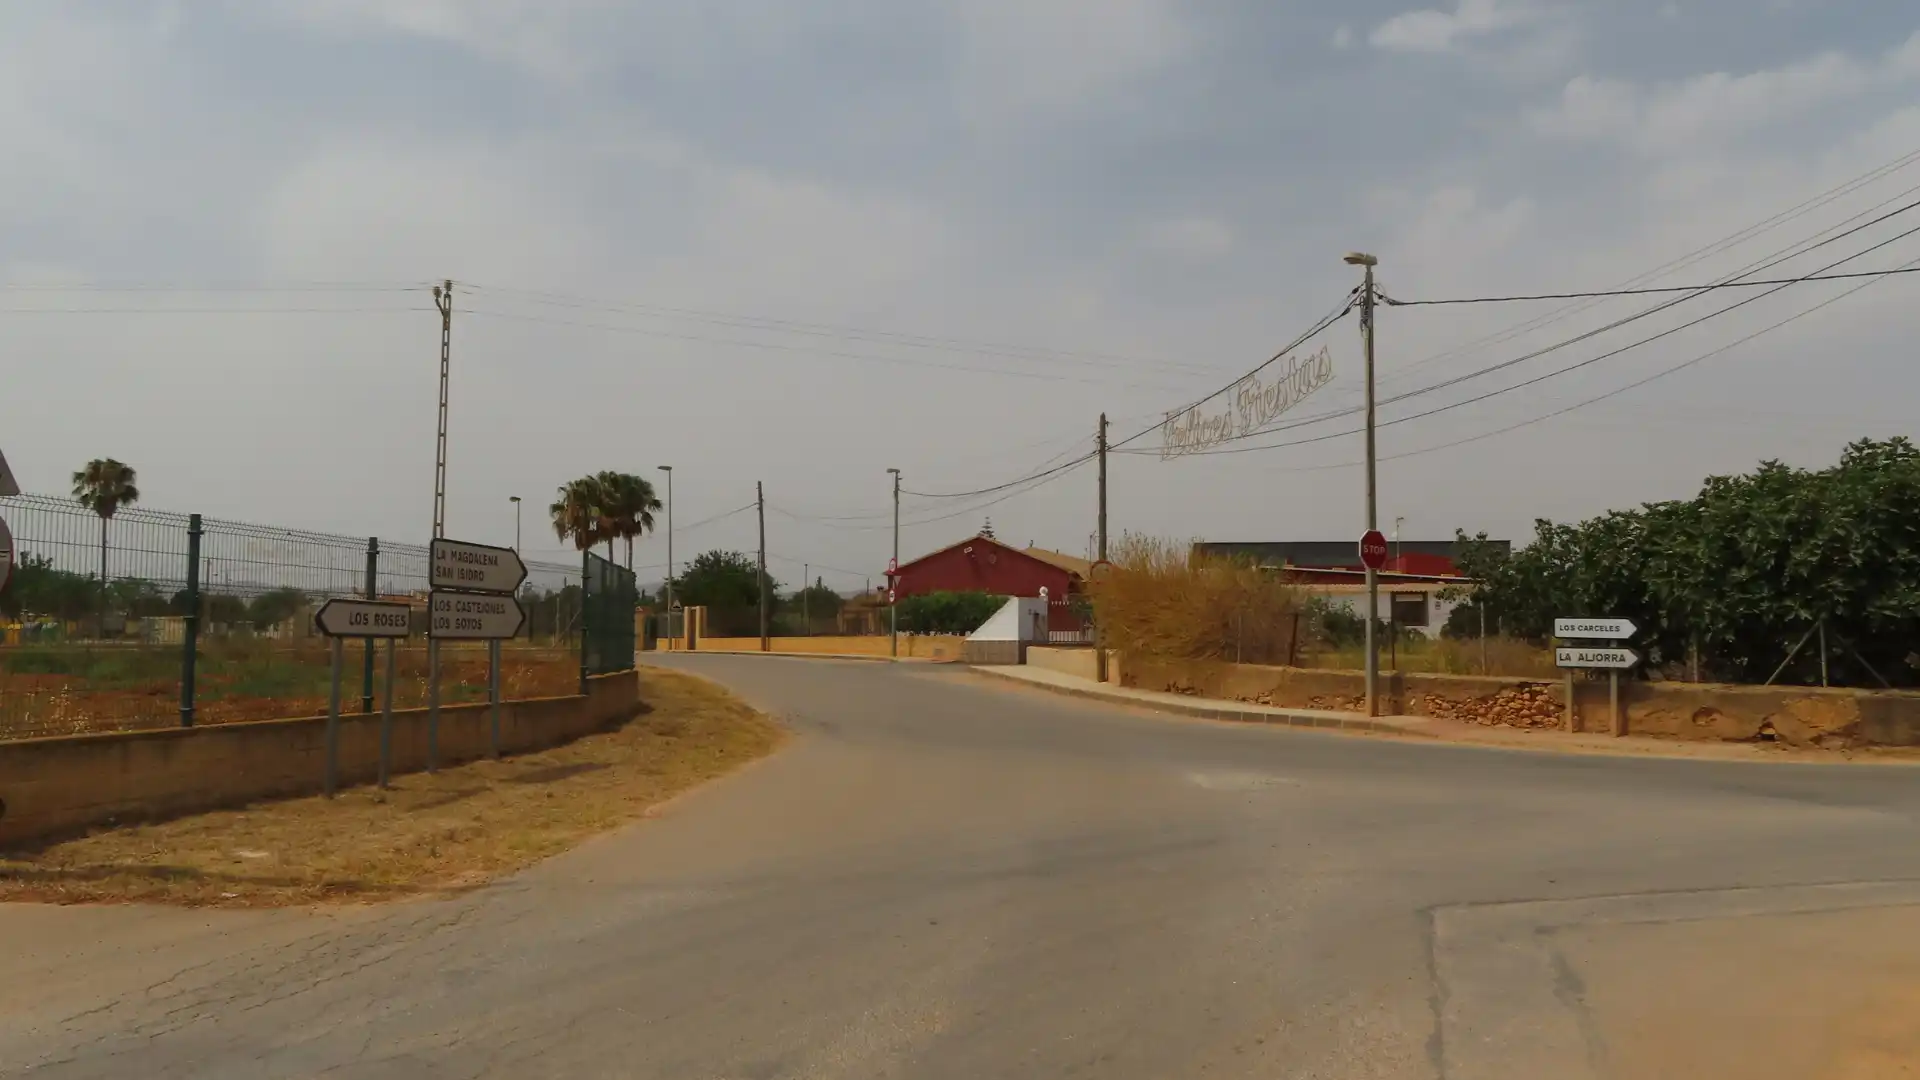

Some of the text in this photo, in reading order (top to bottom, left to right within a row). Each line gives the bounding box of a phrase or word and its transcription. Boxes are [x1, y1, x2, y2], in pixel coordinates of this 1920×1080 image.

[435, 547, 498, 567] LA MAGDALENA
[1364, 544, 1386, 555] STOP
[435, 566, 485, 582] SAN ISIDRO
[434, 600, 506, 615] LOS CASTEJONES
[349, 612, 407, 628] LOS ROSES
[434, 617, 482, 631] LOS SOTOS
[1559, 653, 1626, 662] LA ALJORRA
